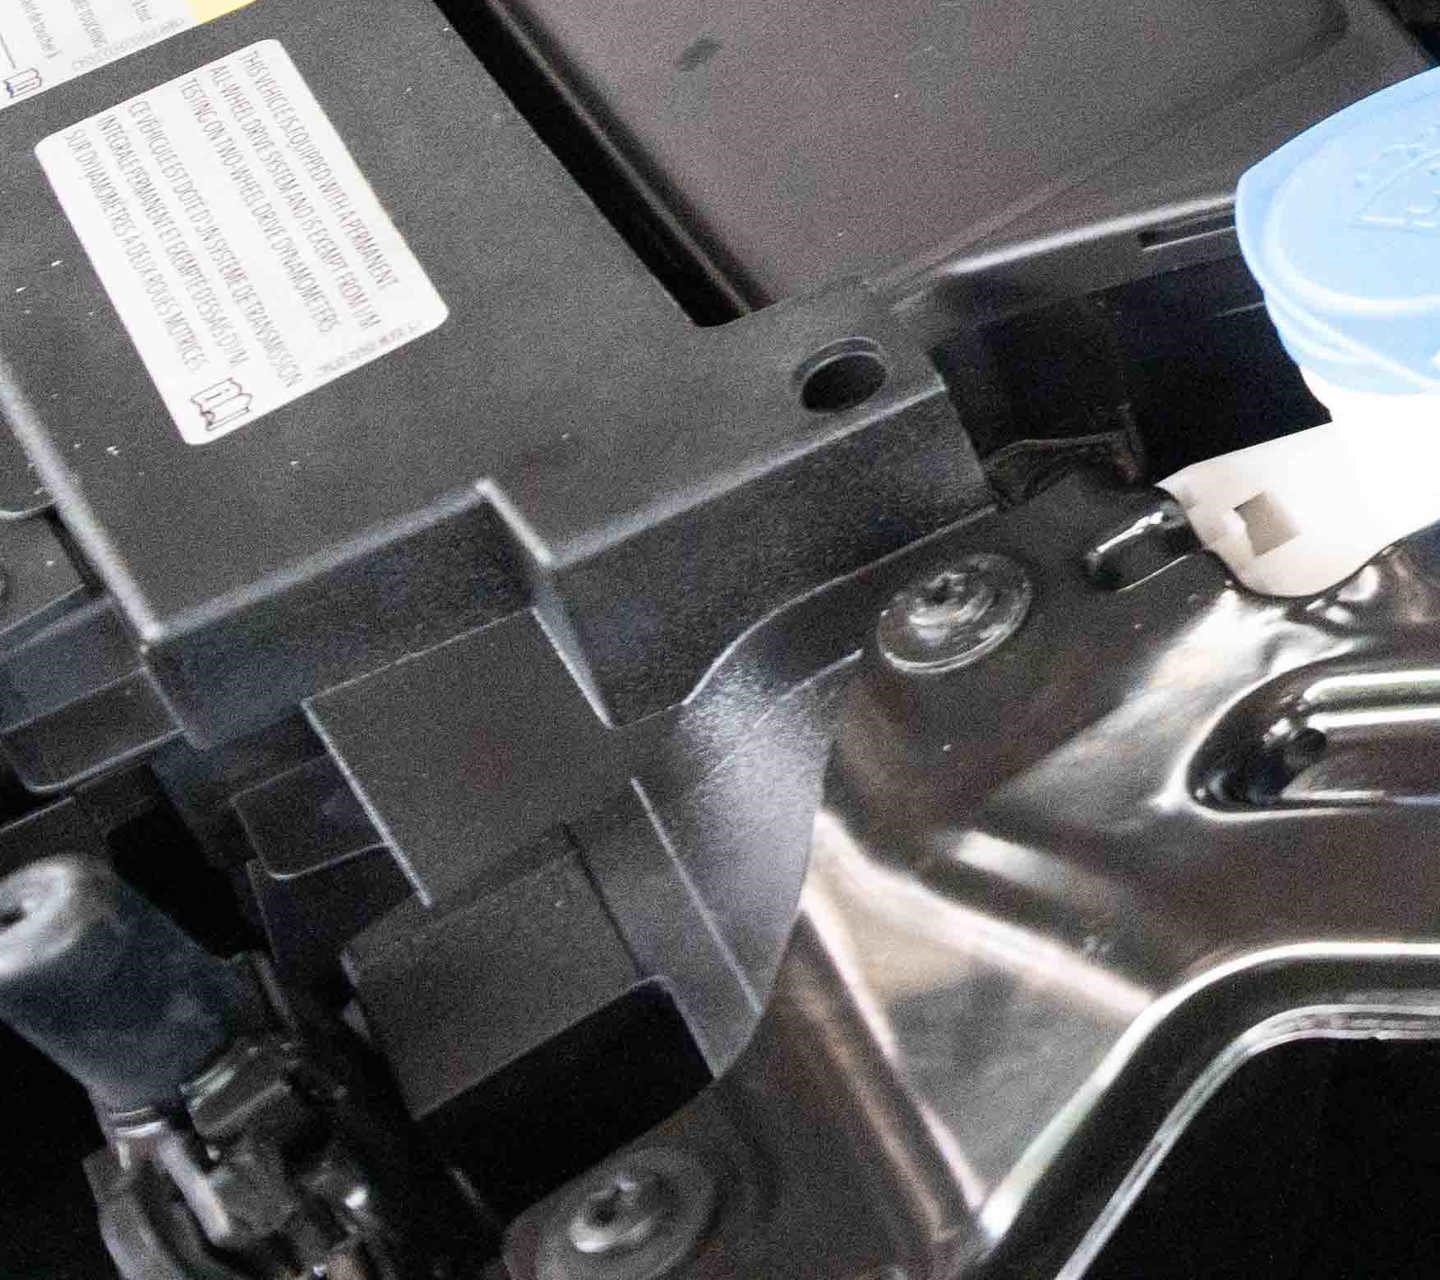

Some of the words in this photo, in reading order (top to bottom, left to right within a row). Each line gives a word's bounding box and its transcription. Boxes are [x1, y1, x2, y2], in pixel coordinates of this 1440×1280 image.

[236, 48, 270, 79] THIS
[125, 98, 153, 119] CE
[175, 76, 220, 126] TESTING
[250, 71, 295, 120] VEHICLE
[60, 126, 93, 156] SUR
[200, 117, 230, 143] ON
[238, 116, 276, 154] DRIVE
[160, 159, 191, 186] EST
[210, 135, 268, 207] TWO-WHEEL
[258, 148, 301, 195] SYSTEM
[282, 123, 334, 184] EQUIPPED
[281, 187, 317, 222] AND
[314, 175, 352, 214] WITH
[155, 224, 184, 246] ET
[249, 200, 288, 241] DRIVE
[297, 214, 324, 234] IS
[333, 207, 359, 224] A
[122, 239, 162, 280] DEUX
[304, 226, 349, 276] EXEMPT
[339, 216, 400, 293] PERMANENT
[139, 270, 183, 318] ROUES
[230, 281, 260, 306] DE
[331, 270, 370, 311] FROM
[240, 298, 308, 389] TRANSMISSION
